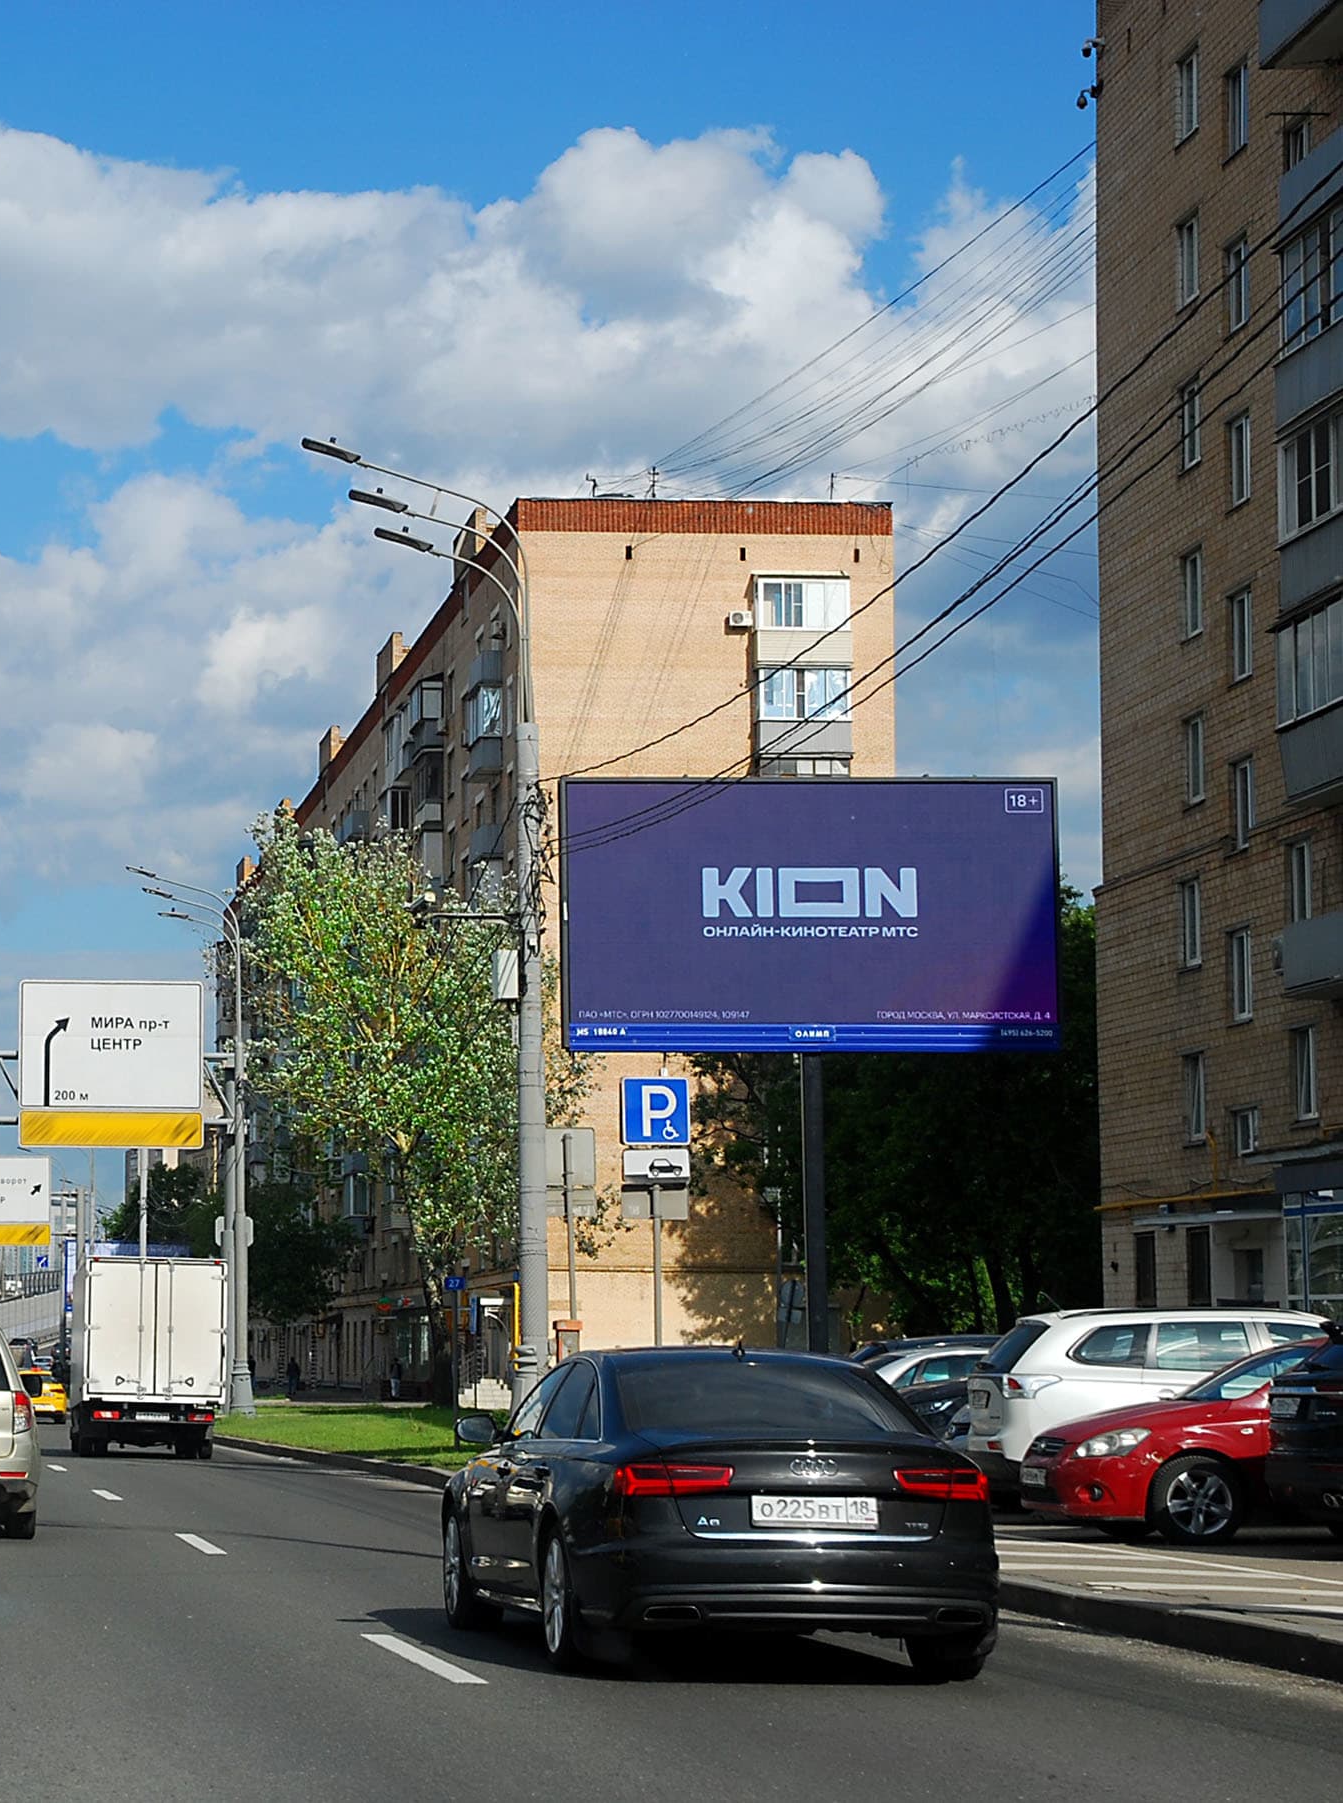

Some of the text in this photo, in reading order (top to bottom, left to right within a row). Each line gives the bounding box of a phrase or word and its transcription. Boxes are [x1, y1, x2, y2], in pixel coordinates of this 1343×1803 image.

[1009, 794, 1038, 807] 18+
[702, 867, 918, 918] KION
[703, 924, 918, 938] ОНЛАЙН-КИНОТЕАТР МТС
[578, 1010, 598, 1019] ПАО
[630, 1010, 654, 1019] ОГРН
[876, 1010, 906, 1020] ГОРОД
[90, 1016, 170, 1032] МИРА пр-т
[90, 1038, 143, 1051] ЦЕНТР
[54, 1090, 89, 1101] 200 м
[641, 1084, 677, 1137] P
[448, 1279, 460, 1288] 27
[760, 1499, 869, 1520] О225ВТ 18
